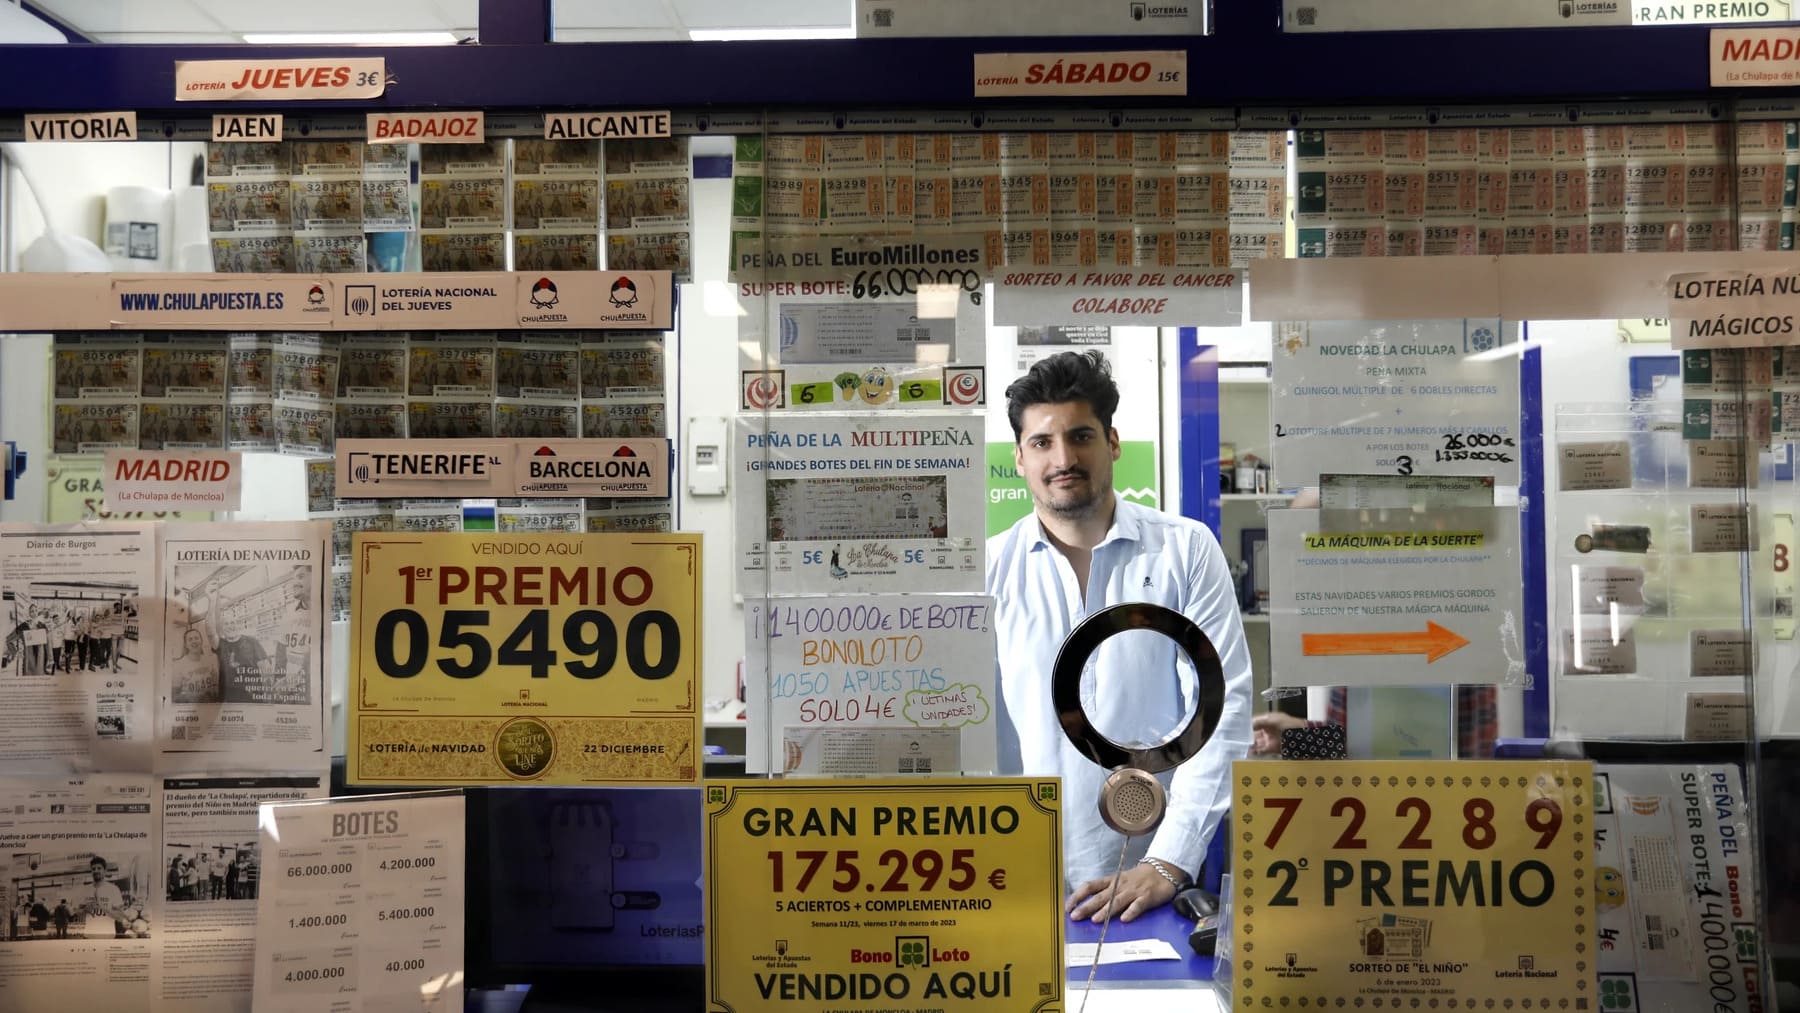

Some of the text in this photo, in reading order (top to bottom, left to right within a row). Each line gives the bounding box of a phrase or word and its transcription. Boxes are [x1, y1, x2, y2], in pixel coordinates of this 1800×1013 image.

[1693, 2, 1769, 18] PREMIO
[185, 66, 379, 91] LOTERÍA JUEVES 3€
[977, 60, 1180, 87] LOTERÍA SÁBADO 15€
[30, 117, 131, 140] VITORIA
[216, 117, 276, 138] JAEN
[375, 116, 479, 138] BADAJOZ
[549, 114, 668, 138] ALICANTE
[741, 244, 980, 268] PEÑA DEL EuroMillones
[741, 279, 851, 297] SUPER BOTE:
[1003, 272, 1235, 288] SORTEO A FAVOR DEL CANCER
[1674, 273, 1765, 299] LOTERÍA
[382, 286, 497, 298] LOTERÍA NACIONAL
[121, 291, 284, 311] WWW.CHULAPUESTA.ES
[382, 300, 452, 311] DEL JUEVES
[1072, 297, 1169, 314] COLABORE
[1689, 313, 1793, 338] MÁGICOS
[1319, 344, 1456, 357] NOVEDAD LA CHULAPA
[1394, 367, 1427, 377] MIXTA
[1294, 385, 1497, 396] QUINIGOL MÚLTIPLE DE 6 DOBLES DIRECTAS
[747, 426, 974, 449] PEÑA DE LA MULTIPEÑA
[115, 458, 230, 482] MADRID
[371, 453, 486, 476] TENERIFE
[529, 460, 651, 479] BARCELONA
[746, 457, 970, 472] ¡GRANDES BOTES DEL FIN DE SEMANA!
[1396, 455, 1413, 476] 3
[118, 490, 225, 502] (La Chulapa de Moncloa)
[990, 487, 1028, 505] gran
[26, 539, 96, 551] Diario de Burgos
[471, 539, 584, 555] VENDIDO AQUÍ
[1328, 534, 1392, 548] MÁQUINA
[1395, 536, 1410, 547] DE
[1413, 536, 1428, 547] LA
[177, 548, 311, 561] LOTERÍA DE NAVIDAD
[803, 550, 824, 565] 5€
[904, 549, 925, 564] 5€
[398, 566, 654, 606] 1er PREMIO
[1295, 588, 1496, 601] ESTAS NAVIDADES VARIOS PREMIOS GORDOS
[1300, 603, 1490, 616] SALIERON DE NUESTRA MÁGICA MÁQUINA
[900, 606, 924, 630] DE
[927, 604, 990, 633] BOTE!
[374, 608, 682, 681] 05490
[802, 634, 924, 667] BONOLOTO
[771, 667, 946, 699] 1050 APUESTAS
[800, 694, 897, 723] SOLO 4€
[369, 742, 418, 754] LOTERÍA
[431, 743, 486, 754] NAVIDAD
[584, 743, 665, 754] 22 DICIEMBRE
[332, 810, 399, 837] BOTES
[743, 805, 1020, 837] GRAN PREMIO
[1681, 772, 1712, 884] SUPER BOTE:
[1711, 772, 1743, 918] PEÑA DEL Bono
[286, 863, 353, 878] 66.000.000
[379, 857, 436, 871] 4.200.000
[767, 848, 1007, 894] 175.295 €
[1266, 857, 1556, 908] 2º PREMIO
[378, 906, 434, 922] 5.400.000
[775, 898, 992, 913] 5 ACIERTOS COMPLEMENTARIO
[288, 913, 347, 929] 1.400.000
[811, 920, 838, 928] Semana
[839, 920, 861, 930] 11/23,
[863, 920, 888, 928] viernes
[889, 920, 897, 928] 17
[930, 919, 939, 927] de
[940, 919, 957, 927] 2023
[850, 948, 893, 964] Bono
[932, 947, 970, 963] Loto
[385, 958, 425, 973] 40.000
[1349, 961, 1469, 974] SORTEO DE "EL NIÑO"
[284, 966, 345, 983] 4.000.000
[754, 964, 1014, 1001] VENDIDO AQUÍ
[1376, 978, 1382, 986] 6
[1384, 977, 1394, 986] de
[1420, 977, 1441, 986] 2023
